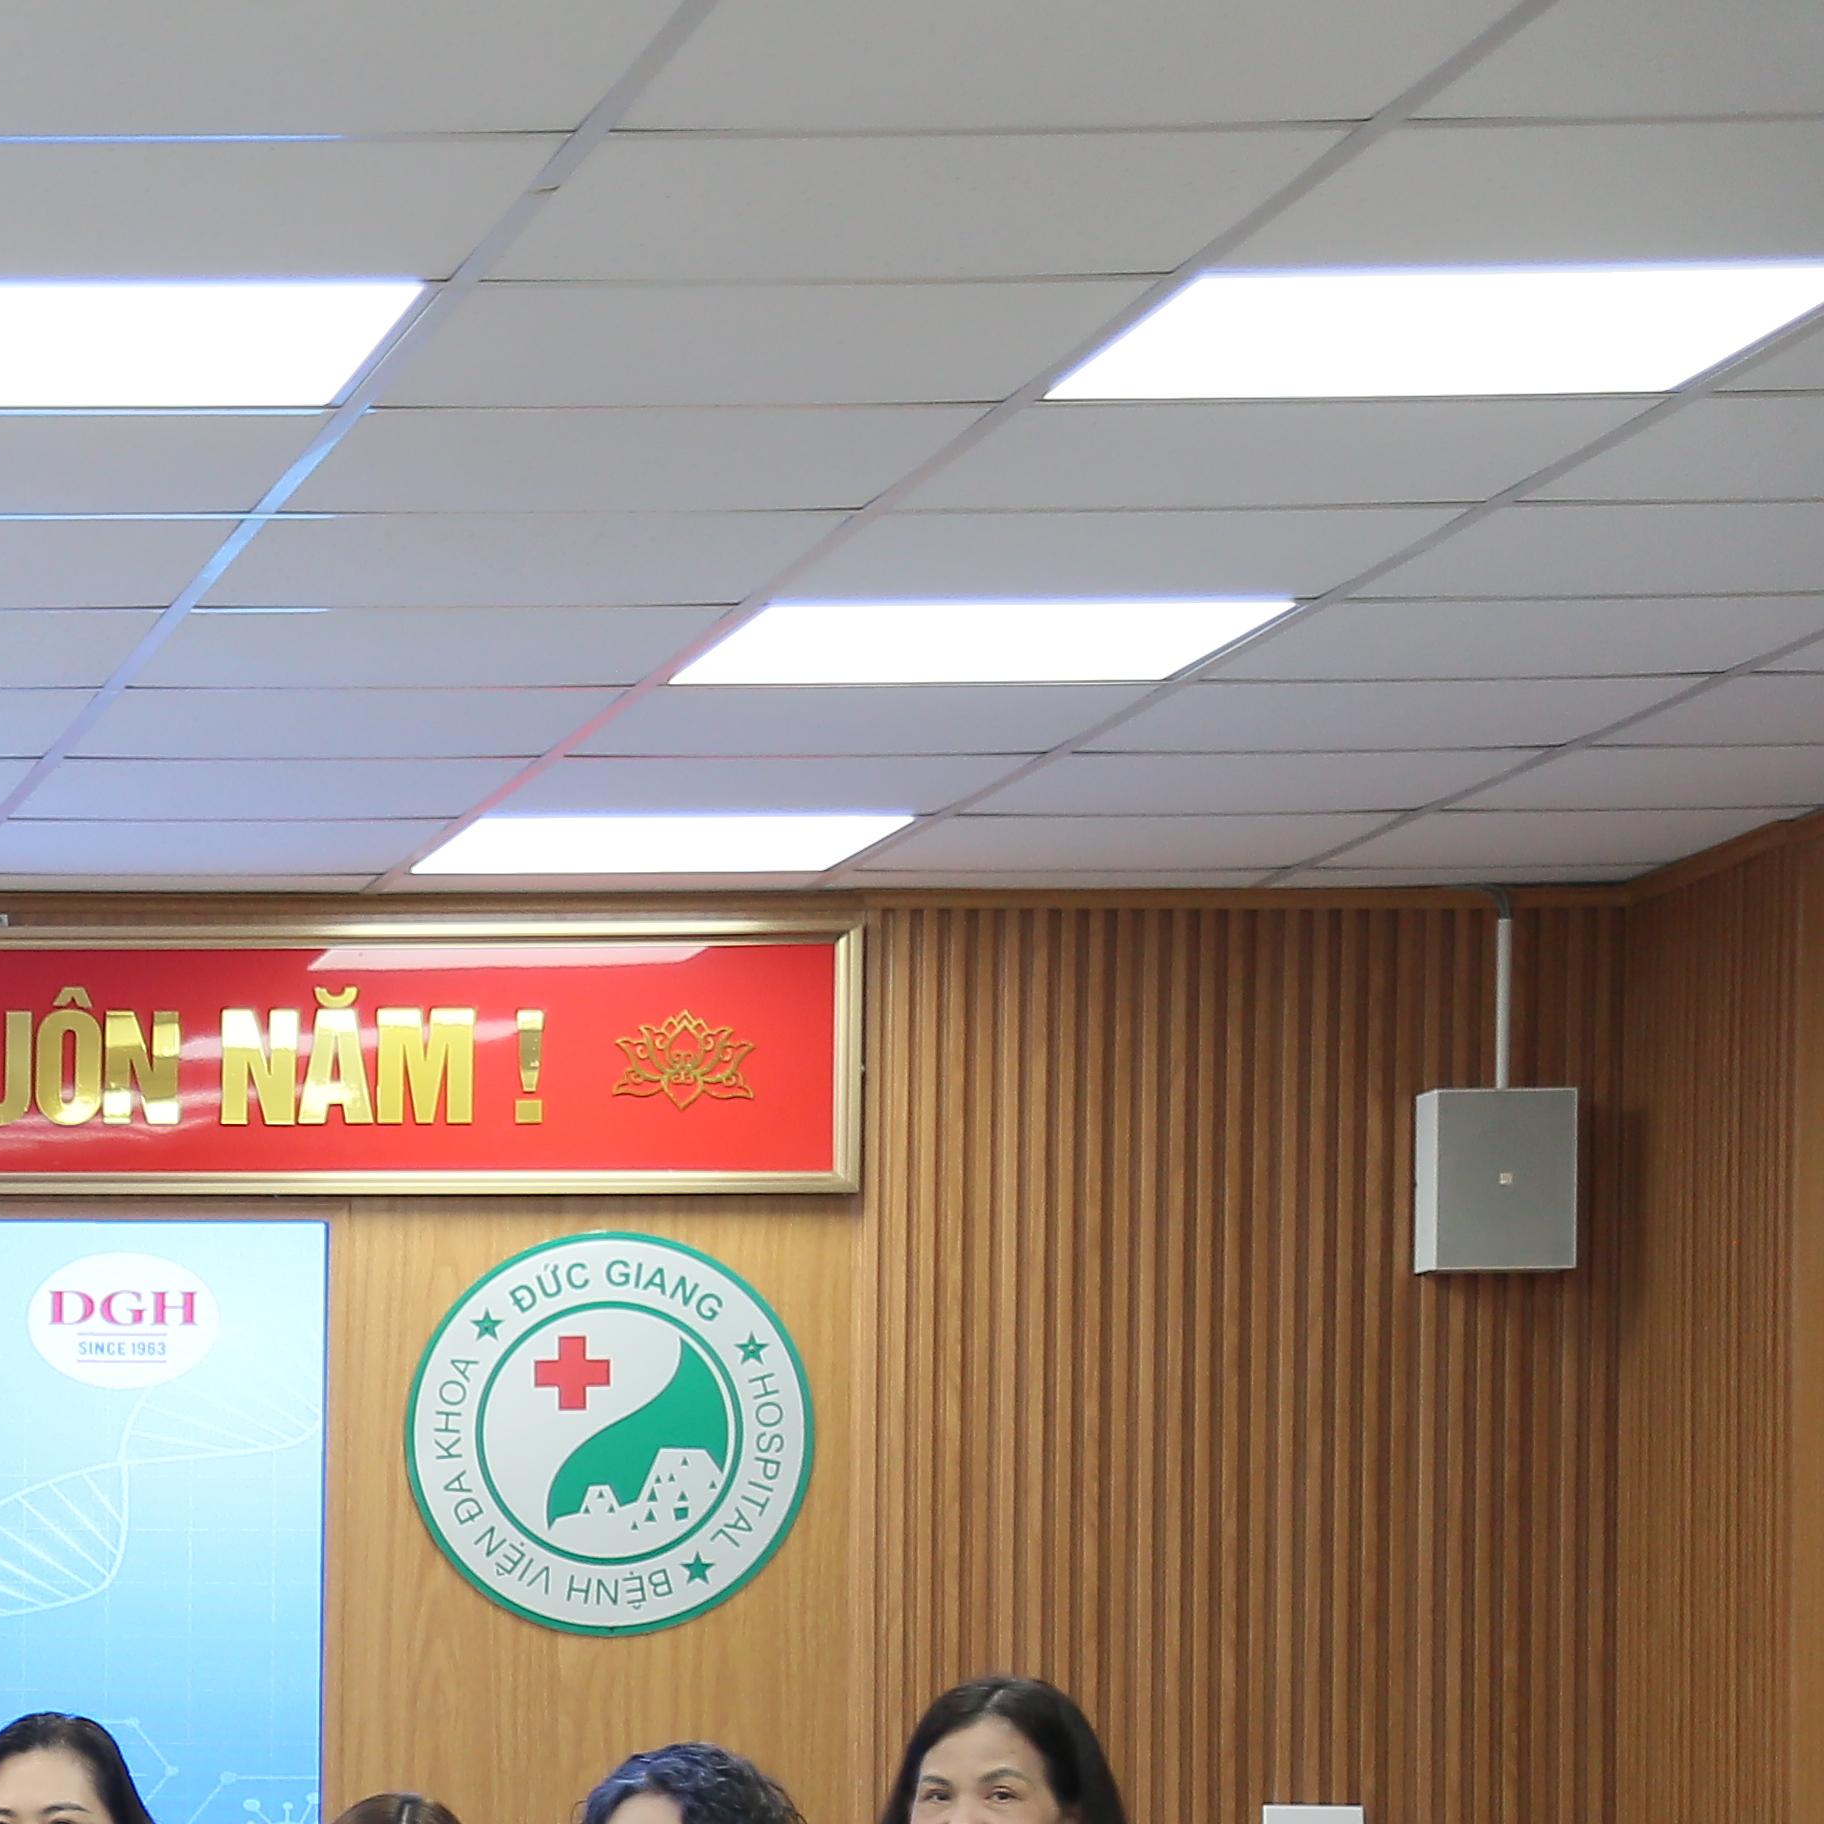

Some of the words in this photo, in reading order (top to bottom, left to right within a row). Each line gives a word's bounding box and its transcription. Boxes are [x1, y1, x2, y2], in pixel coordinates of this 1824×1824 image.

[220, 985, 476, 1128] NĂM
[512, 1010, 547, 1126] !
[48, 1290, 199, 1326] DGH
[508, 1260, 592, 1314] ĐỨC
[604, 1259, 725, 1323] GIANG
[78, 1341, 126, 1355] SINCE
[433, 1355, 481, 1461] KHOA
[709, 1371, 785, 1549] HOSPITAL
[443, 1469, 485, 1527] ĐA
[473, 1524, 553, 1596] VIỆN
[565, 1567, 675, 1612] BỆNH
